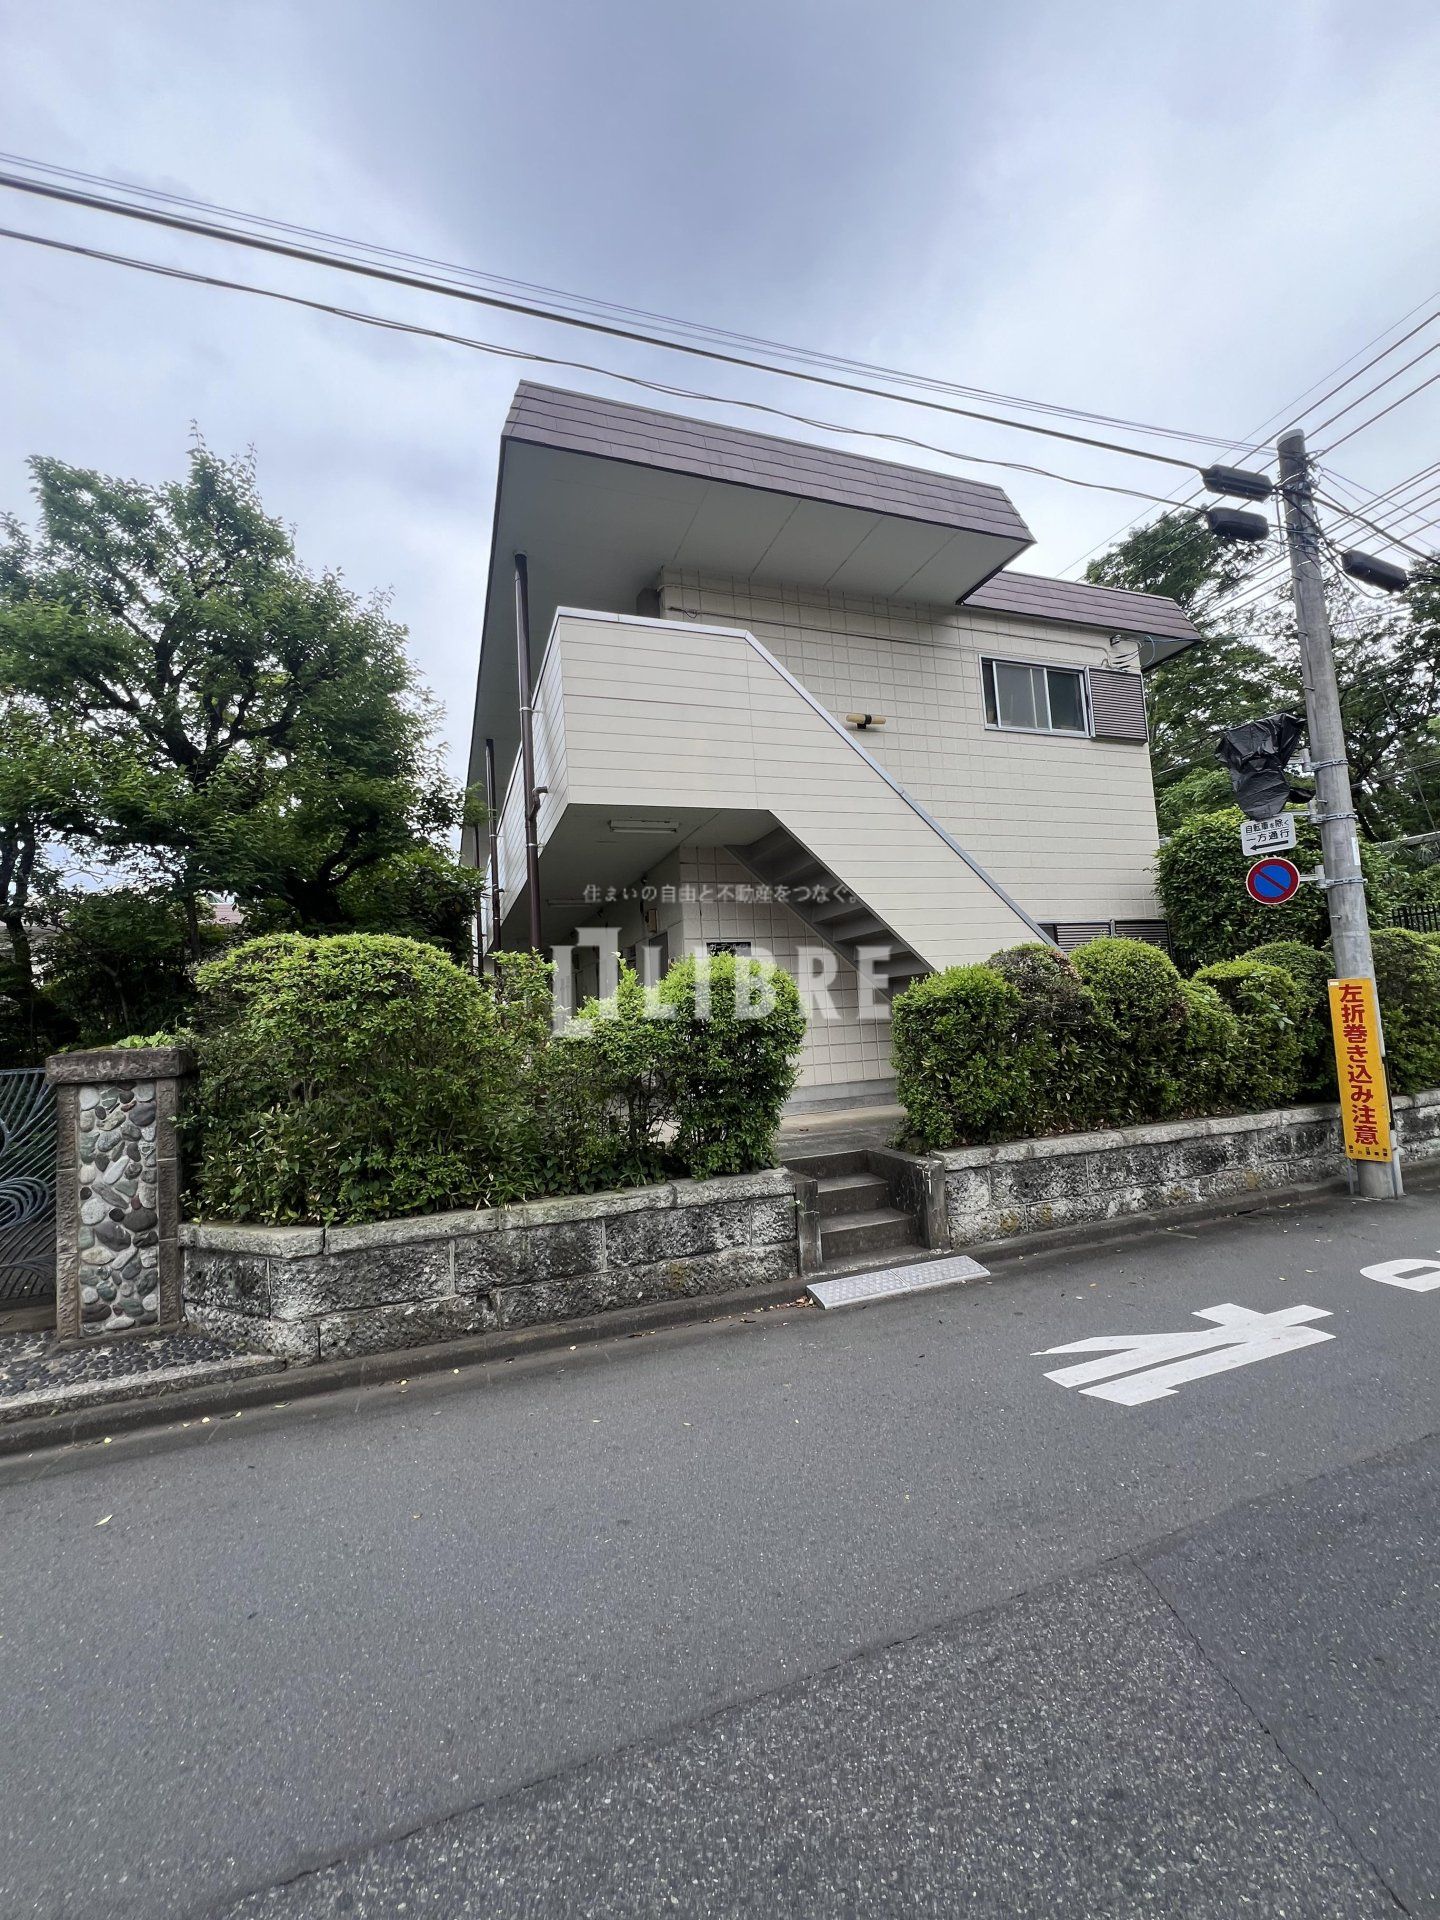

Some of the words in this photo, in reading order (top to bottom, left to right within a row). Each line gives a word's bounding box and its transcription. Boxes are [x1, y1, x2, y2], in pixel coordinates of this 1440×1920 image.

[1246, 819, 1289, 833] 自転車を除く
[1246, 830, 1289, 842] 一方通行
[1339, 984, 1379, 1145] 左折巻き込み注意
